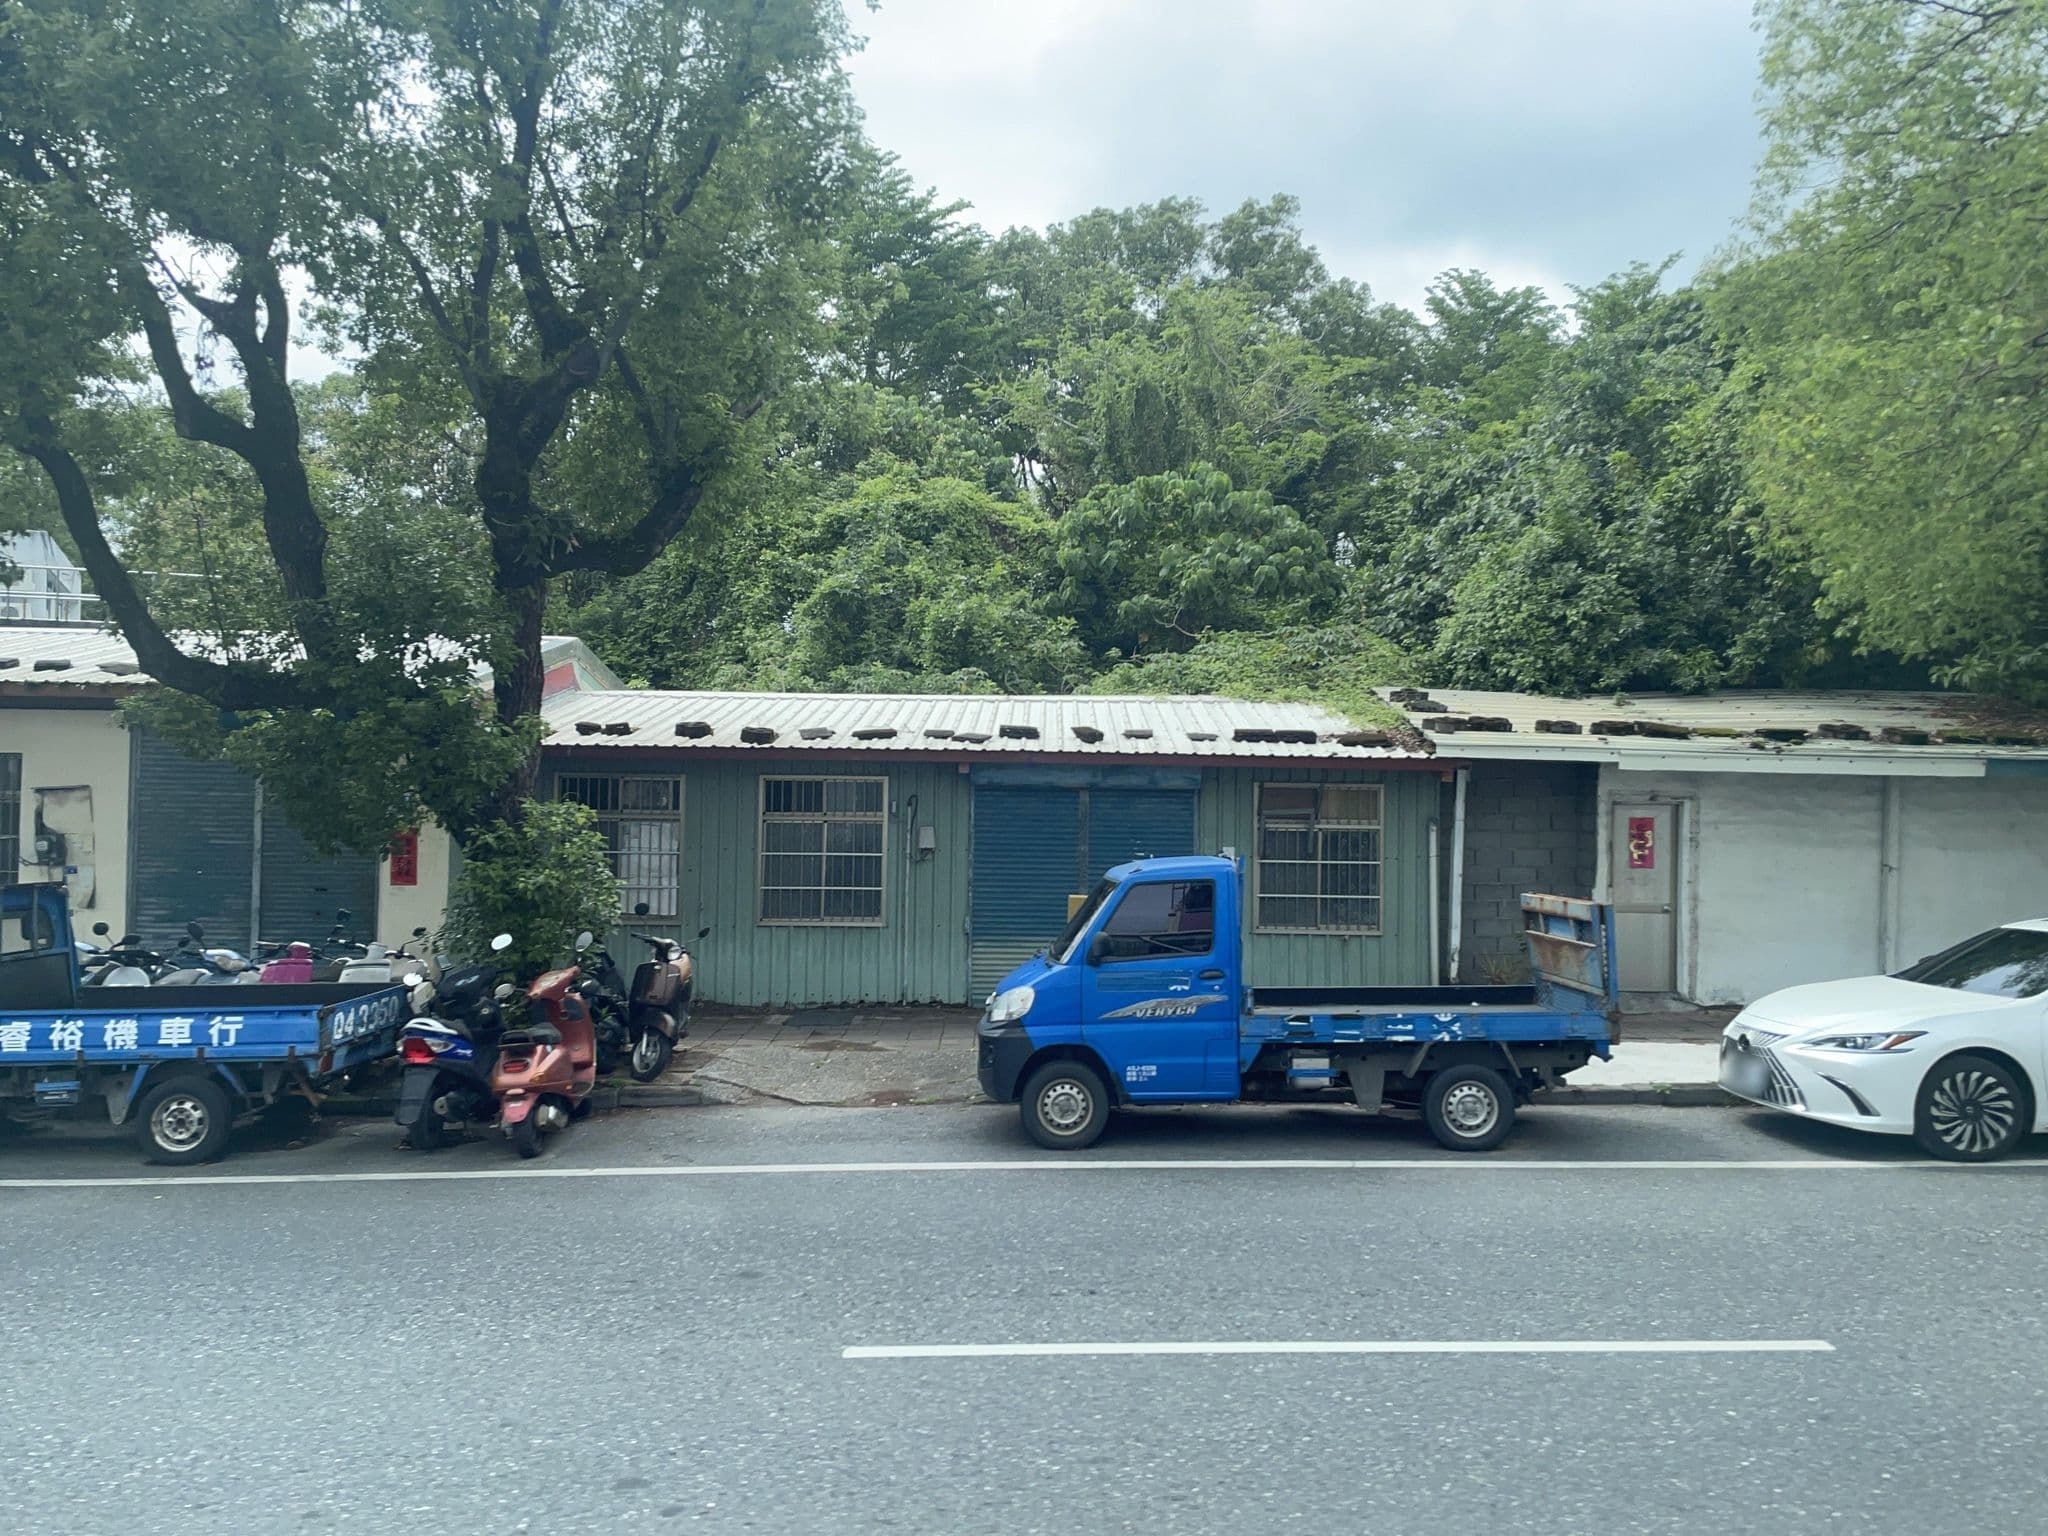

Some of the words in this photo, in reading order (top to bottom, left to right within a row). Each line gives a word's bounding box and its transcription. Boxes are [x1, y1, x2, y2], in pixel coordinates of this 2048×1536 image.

[0, 1015, 244, 1053] 睿裕機車行
